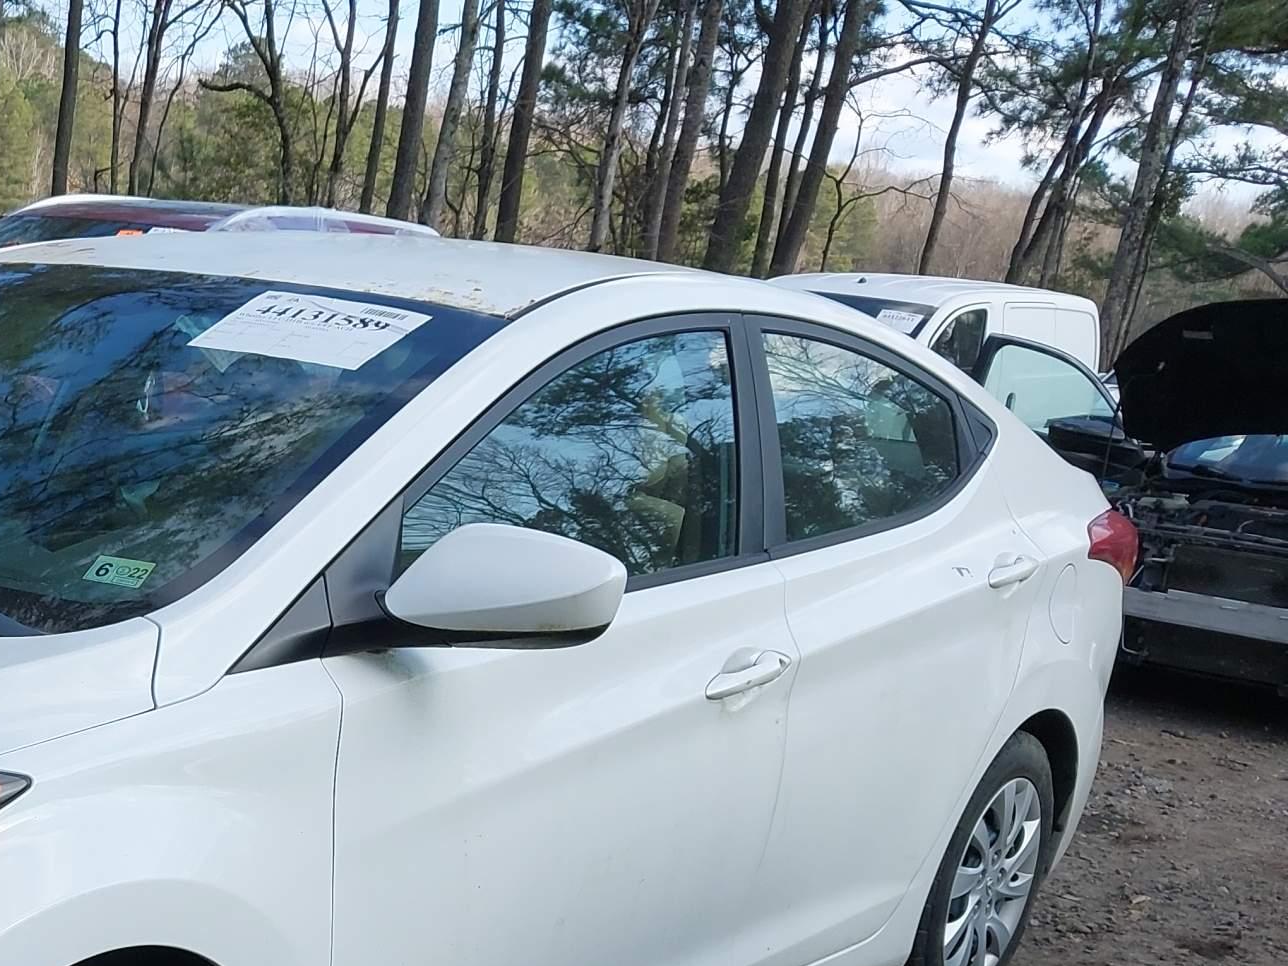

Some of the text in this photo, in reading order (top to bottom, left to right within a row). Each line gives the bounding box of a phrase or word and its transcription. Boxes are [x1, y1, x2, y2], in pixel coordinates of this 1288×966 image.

[255, 303, 390, 332] 44131589
[95, 562, 149, 580] 6 22
